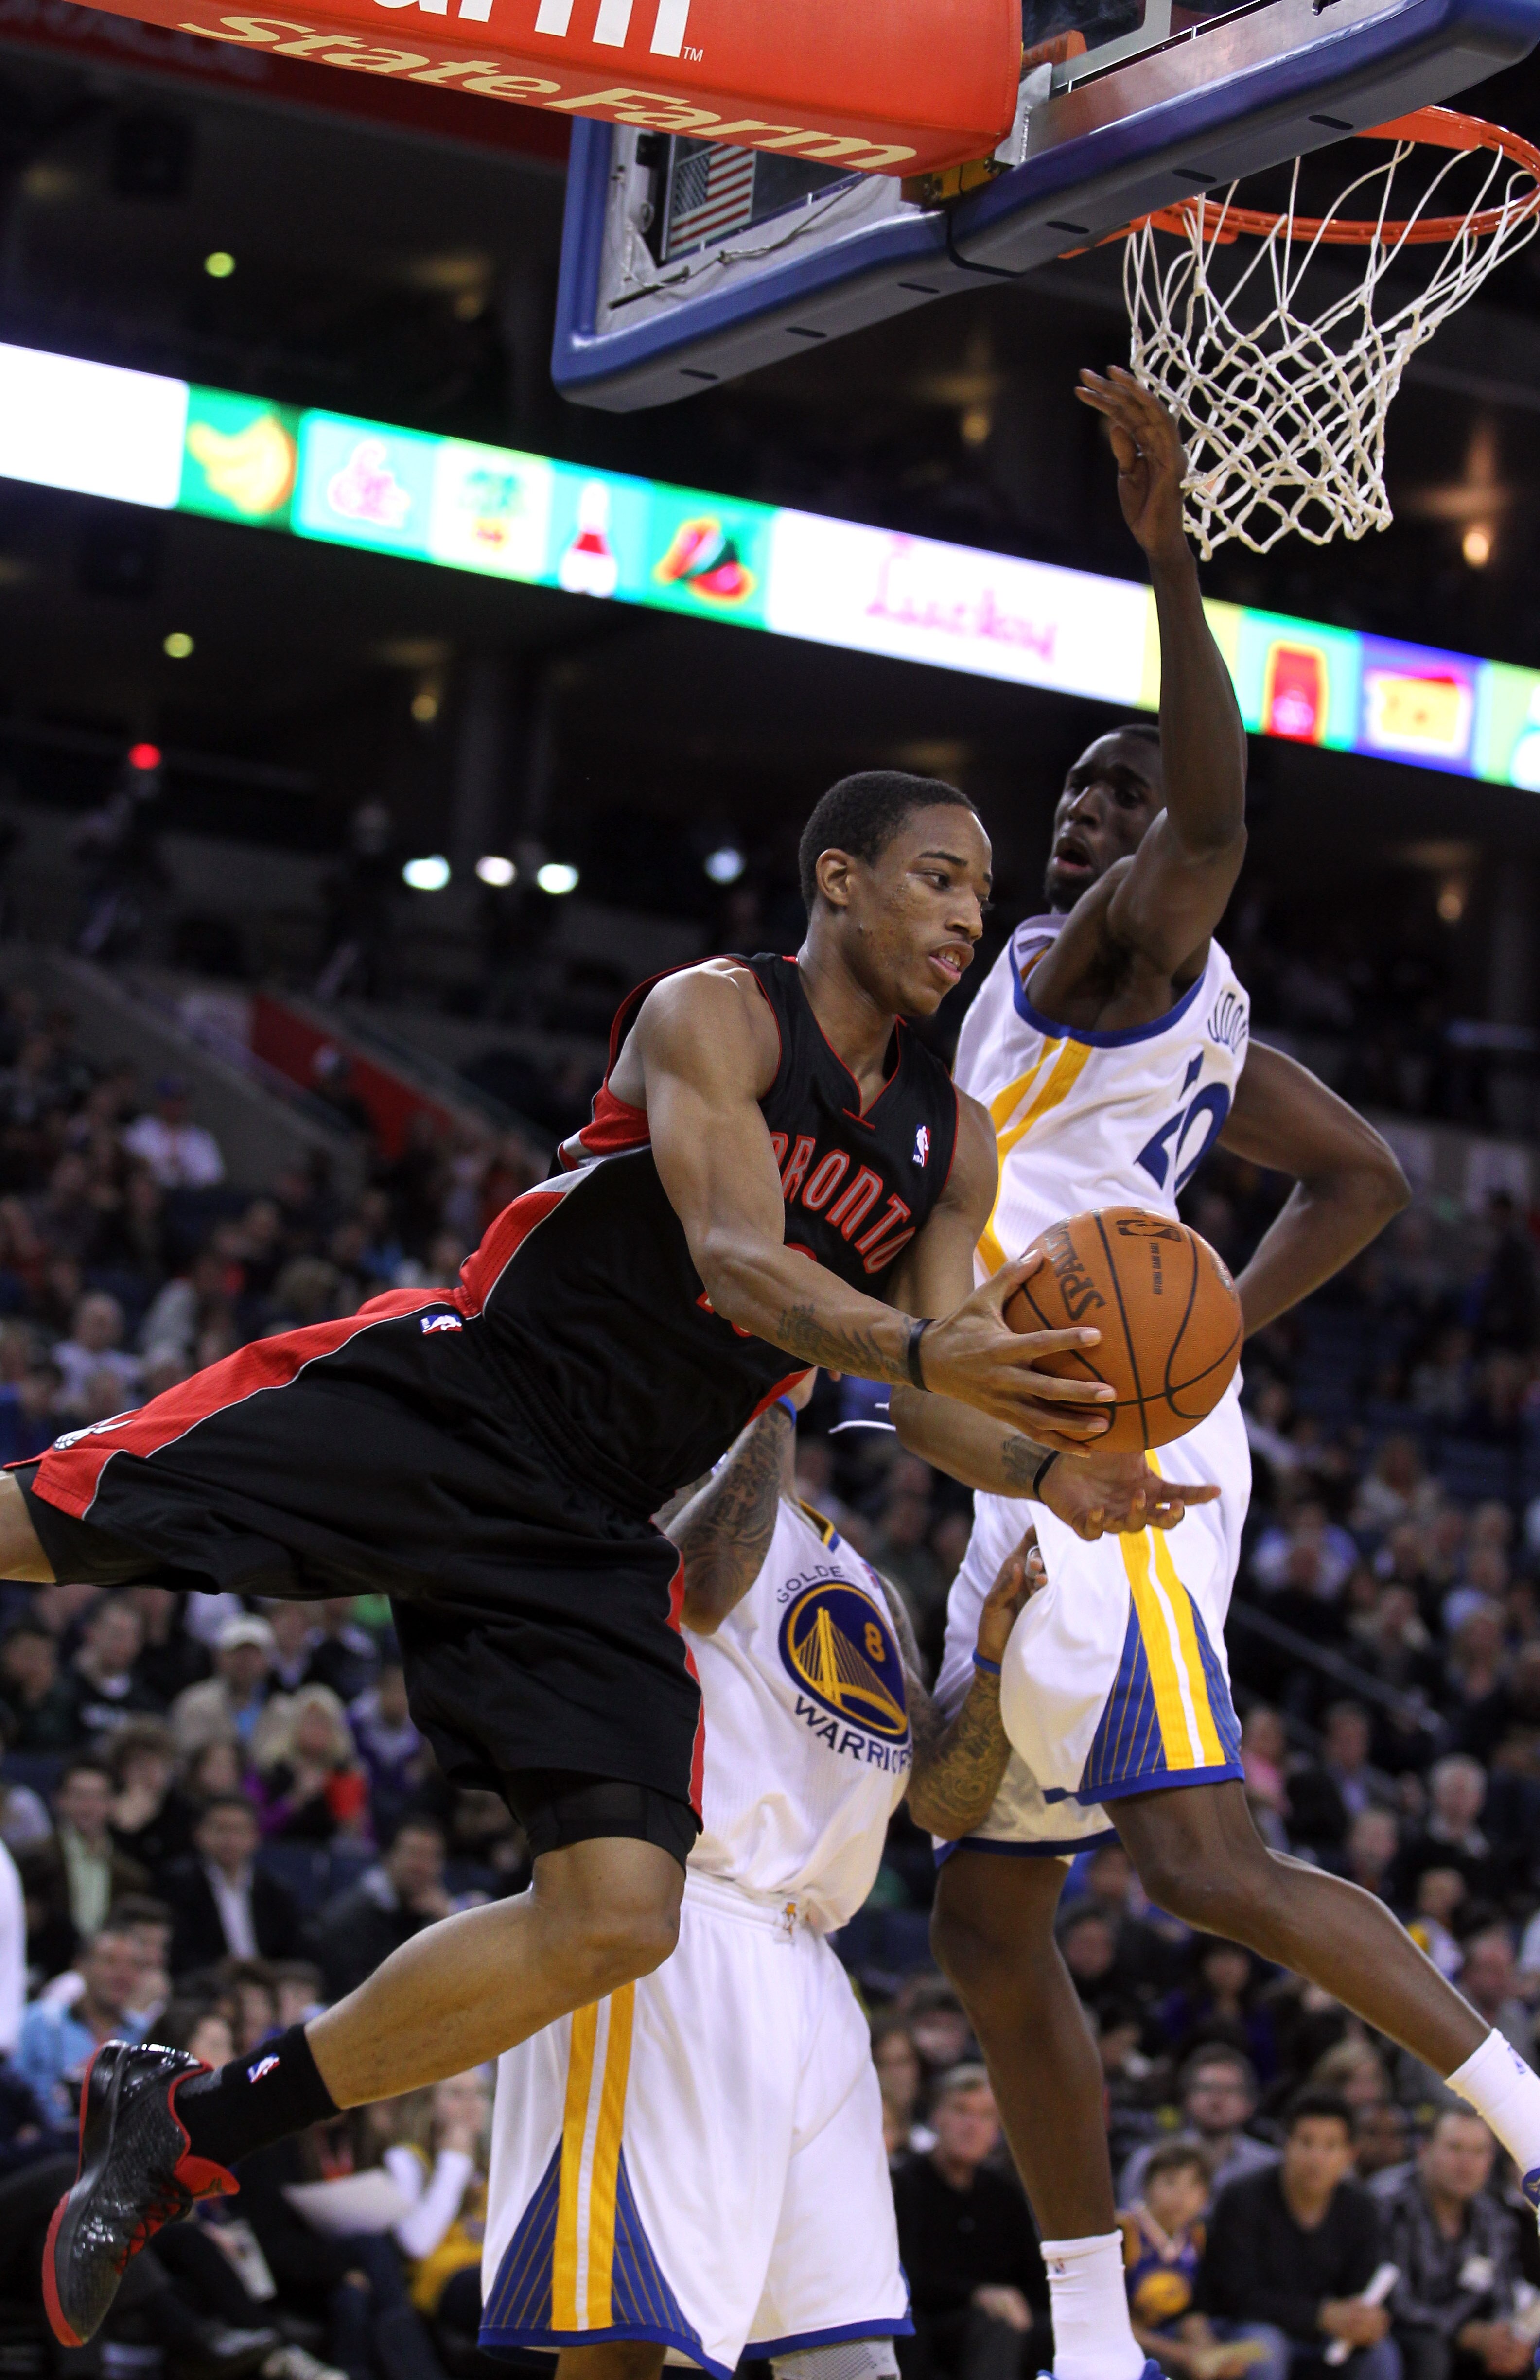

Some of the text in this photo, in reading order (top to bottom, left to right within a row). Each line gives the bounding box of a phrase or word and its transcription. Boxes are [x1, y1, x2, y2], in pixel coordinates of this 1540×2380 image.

[177, 16, 561, 98] State
[542, 88, 917, 169] Farm
[863, 1621, 886, 1663] 8
[795, 1694, 913, 1775] WARRIOR
